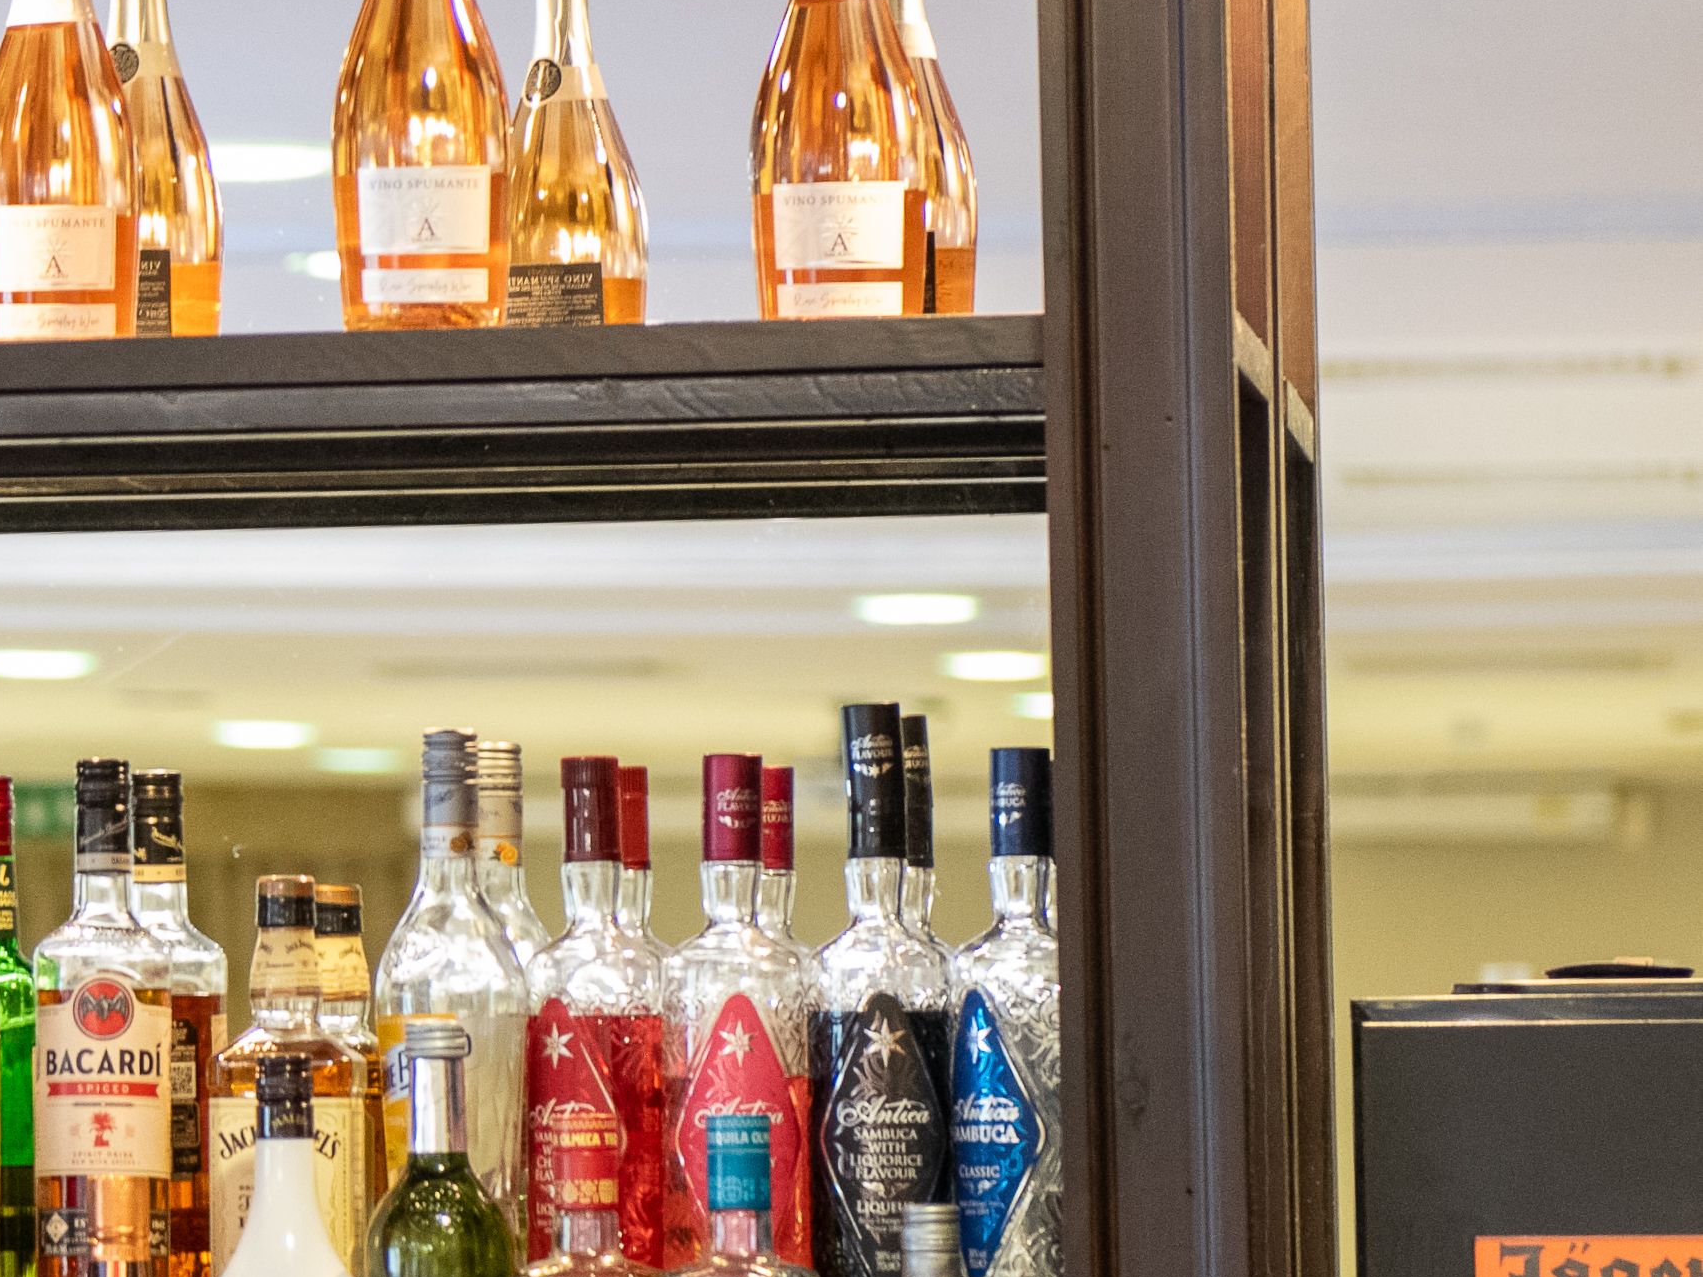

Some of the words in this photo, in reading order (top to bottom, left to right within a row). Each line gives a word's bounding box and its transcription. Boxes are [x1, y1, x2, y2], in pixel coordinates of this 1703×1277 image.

[46, 1043, 162, 1077] BACARDÍ
[76, 1083, 130, 1094] SPICED
[853, 1128, 918, 1140] SAMBUCA
[868, 1142, 906, 1153] WITH
[850, 1154, 923, 1167] LIQUORICE
[855, 1167, 917, 1179] FLAVOUR
[959, 1166, 1000, 1178] CLASSIC
